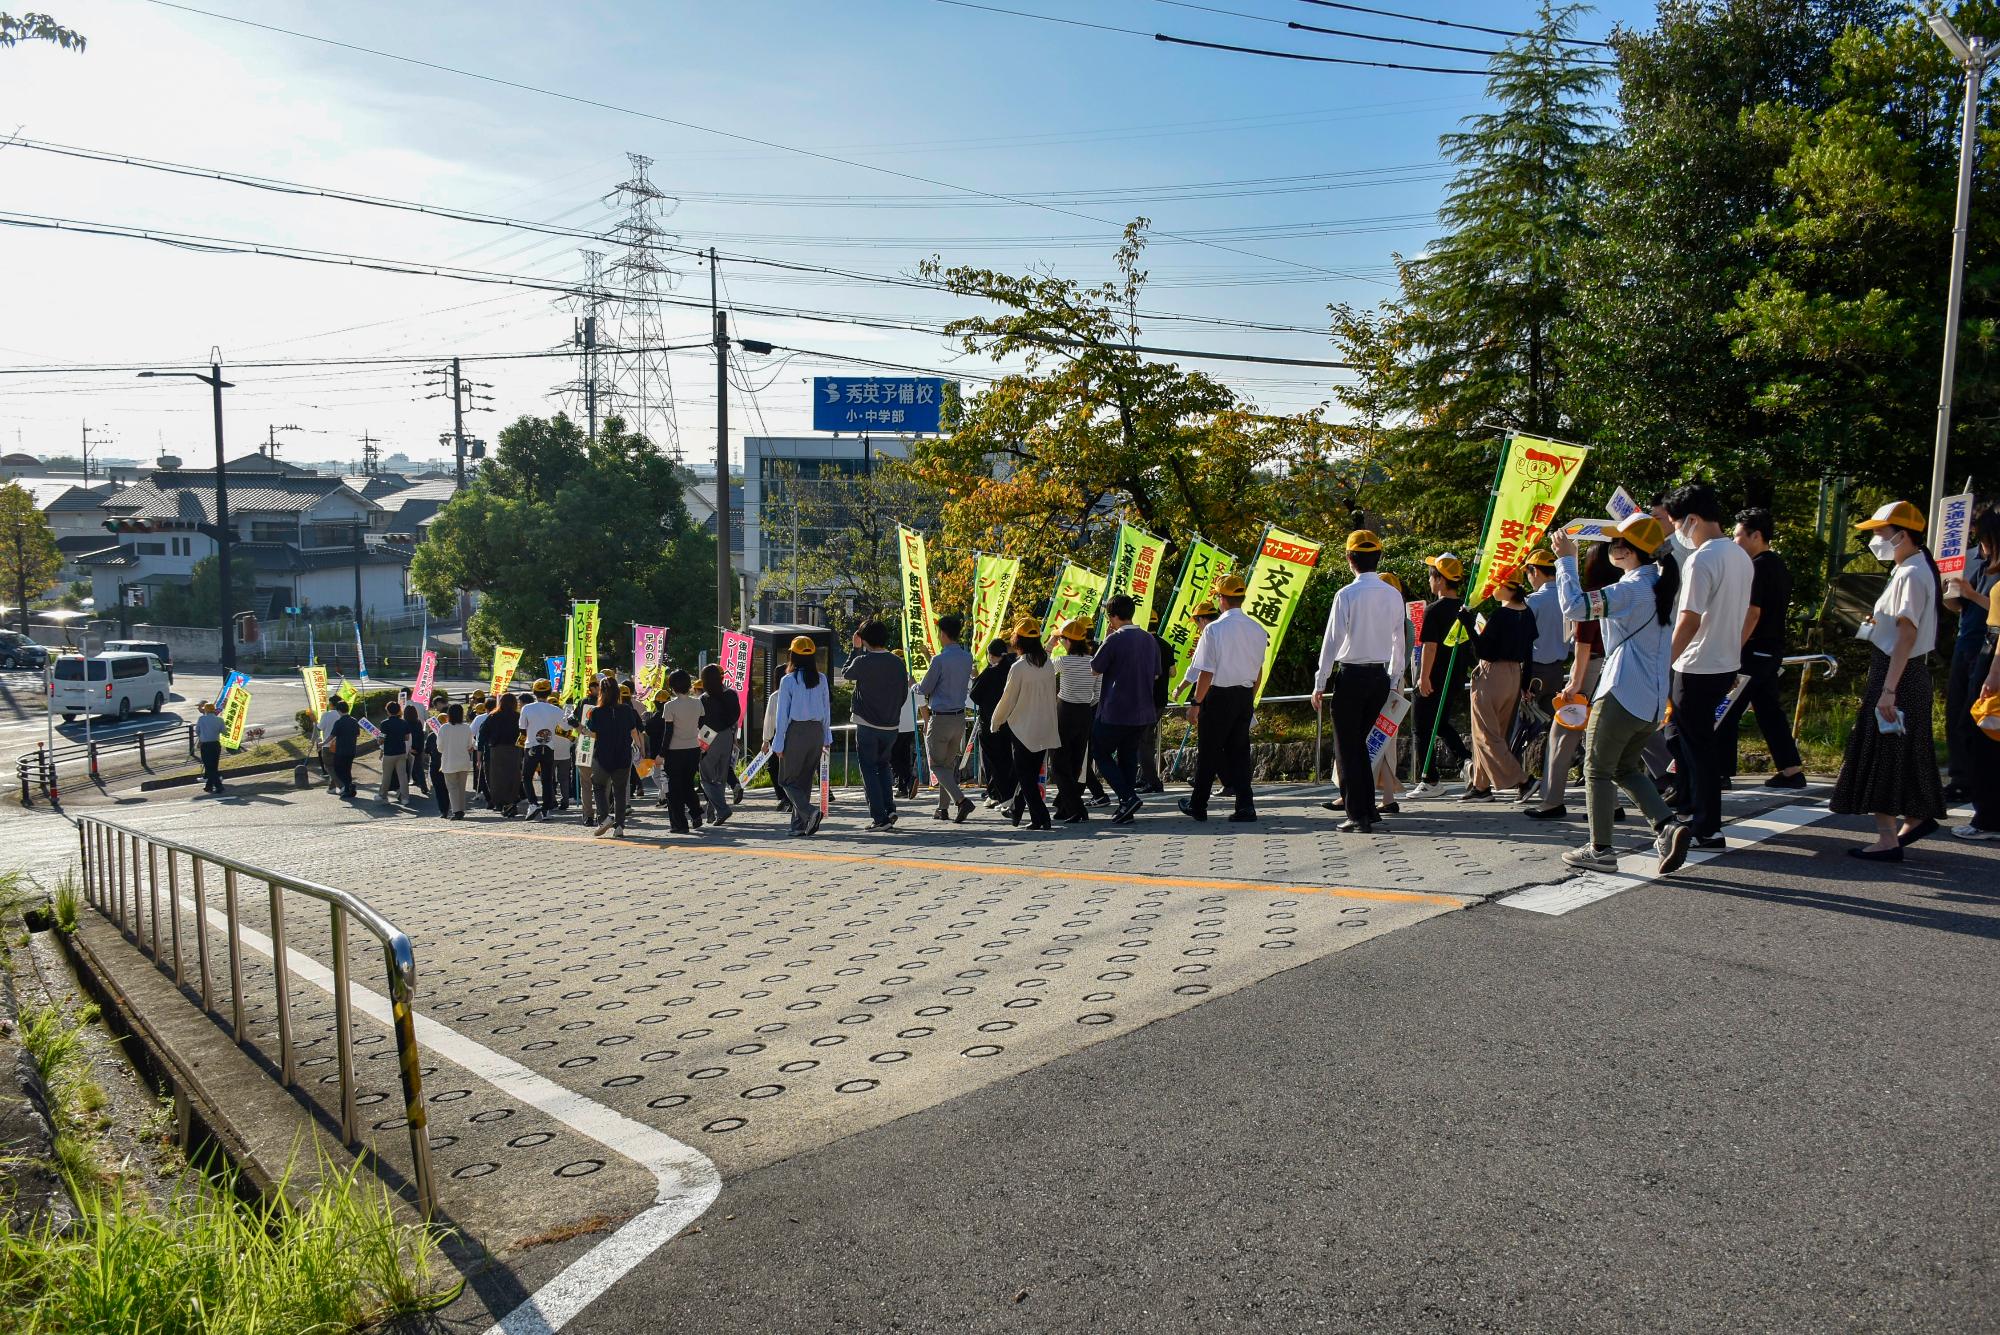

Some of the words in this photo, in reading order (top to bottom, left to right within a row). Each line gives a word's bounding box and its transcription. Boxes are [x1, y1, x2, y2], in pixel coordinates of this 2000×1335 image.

[846, 383, 933, 405] 秀英予備校
[846, 409, 905, 423] 小・中学部
[1940, 500, 1967, 559] 交通安全運動
[1265, 541, 1314, 563] マナーアップ
[1937, 559, 1962, 572] 実施中
[1131, 546, 1157, 608] 高齢者を
[734, 640, 748, 691] 後部座席も
